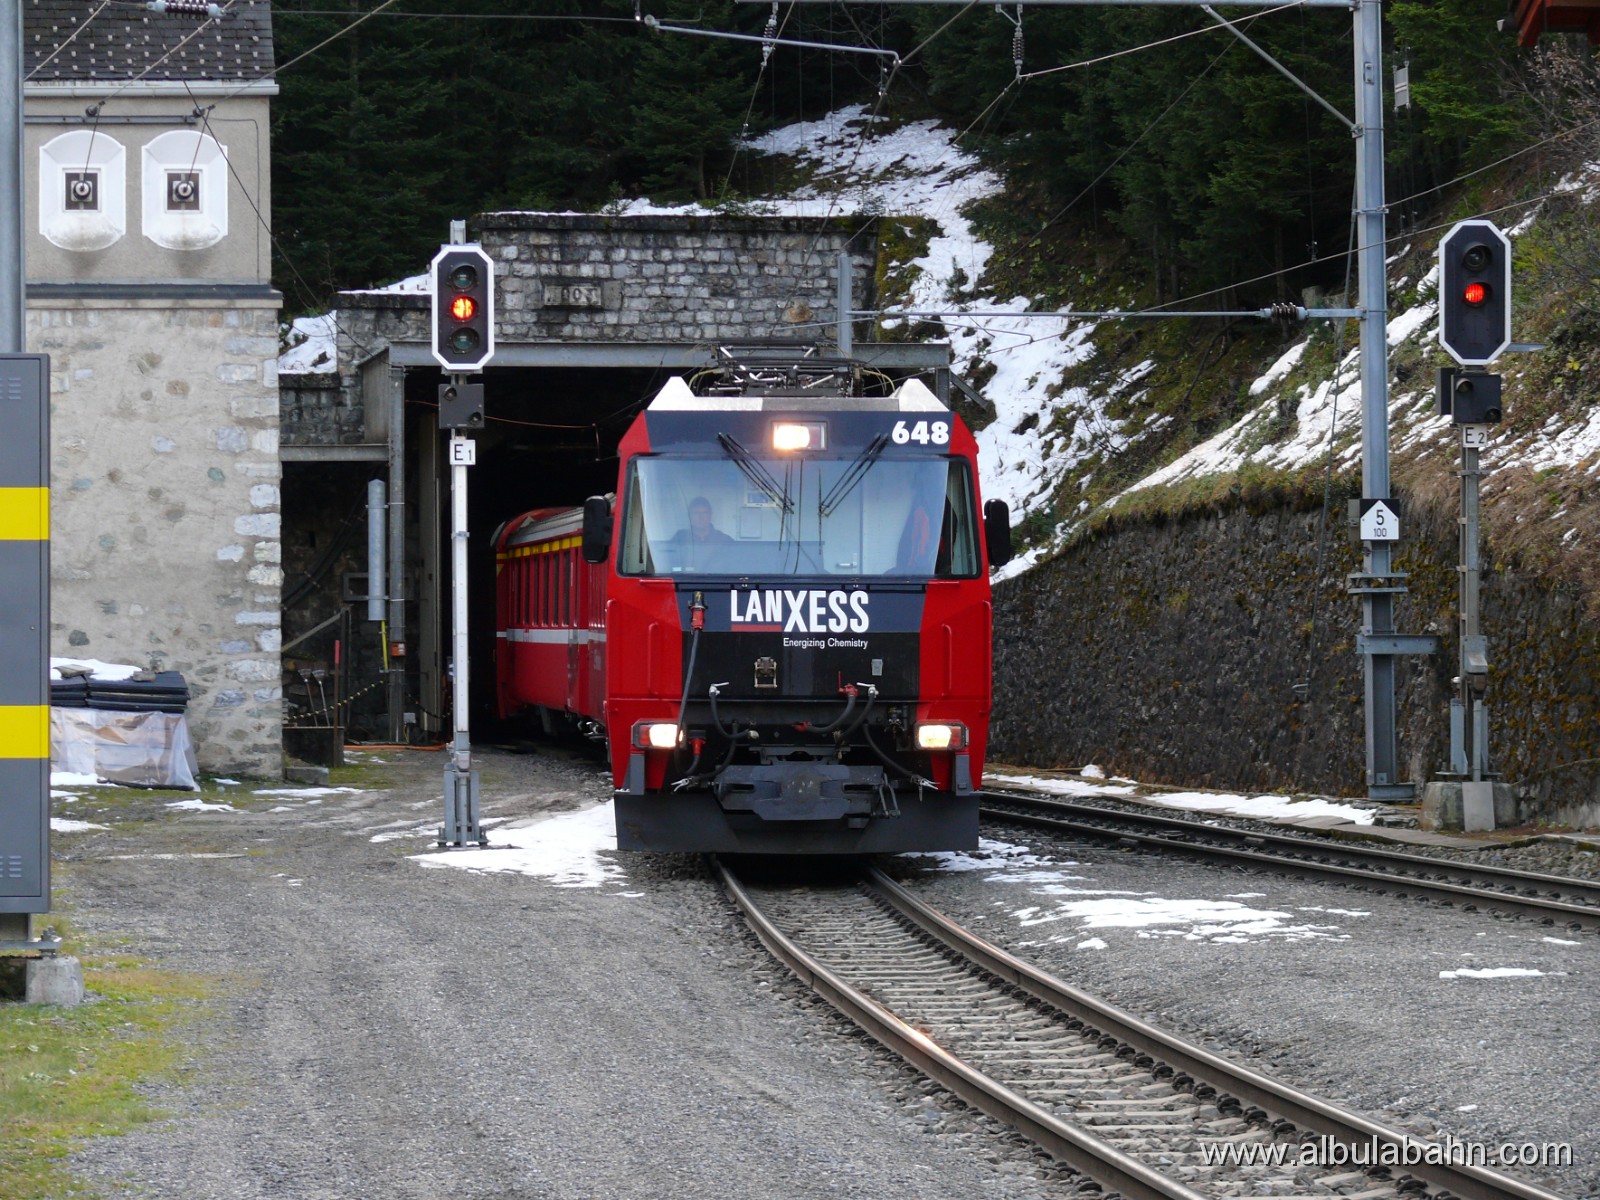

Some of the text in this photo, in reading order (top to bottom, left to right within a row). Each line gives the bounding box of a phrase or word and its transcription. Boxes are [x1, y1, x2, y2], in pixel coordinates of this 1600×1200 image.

[892, 421, 949, 444] 648
[1376, 509, 1385, 526] 5
[1373, 528, 1387, 537] 100
[731, 590, 869, 633] LANXESS
[783, 638, 868, 649] Energizing Chemistry
